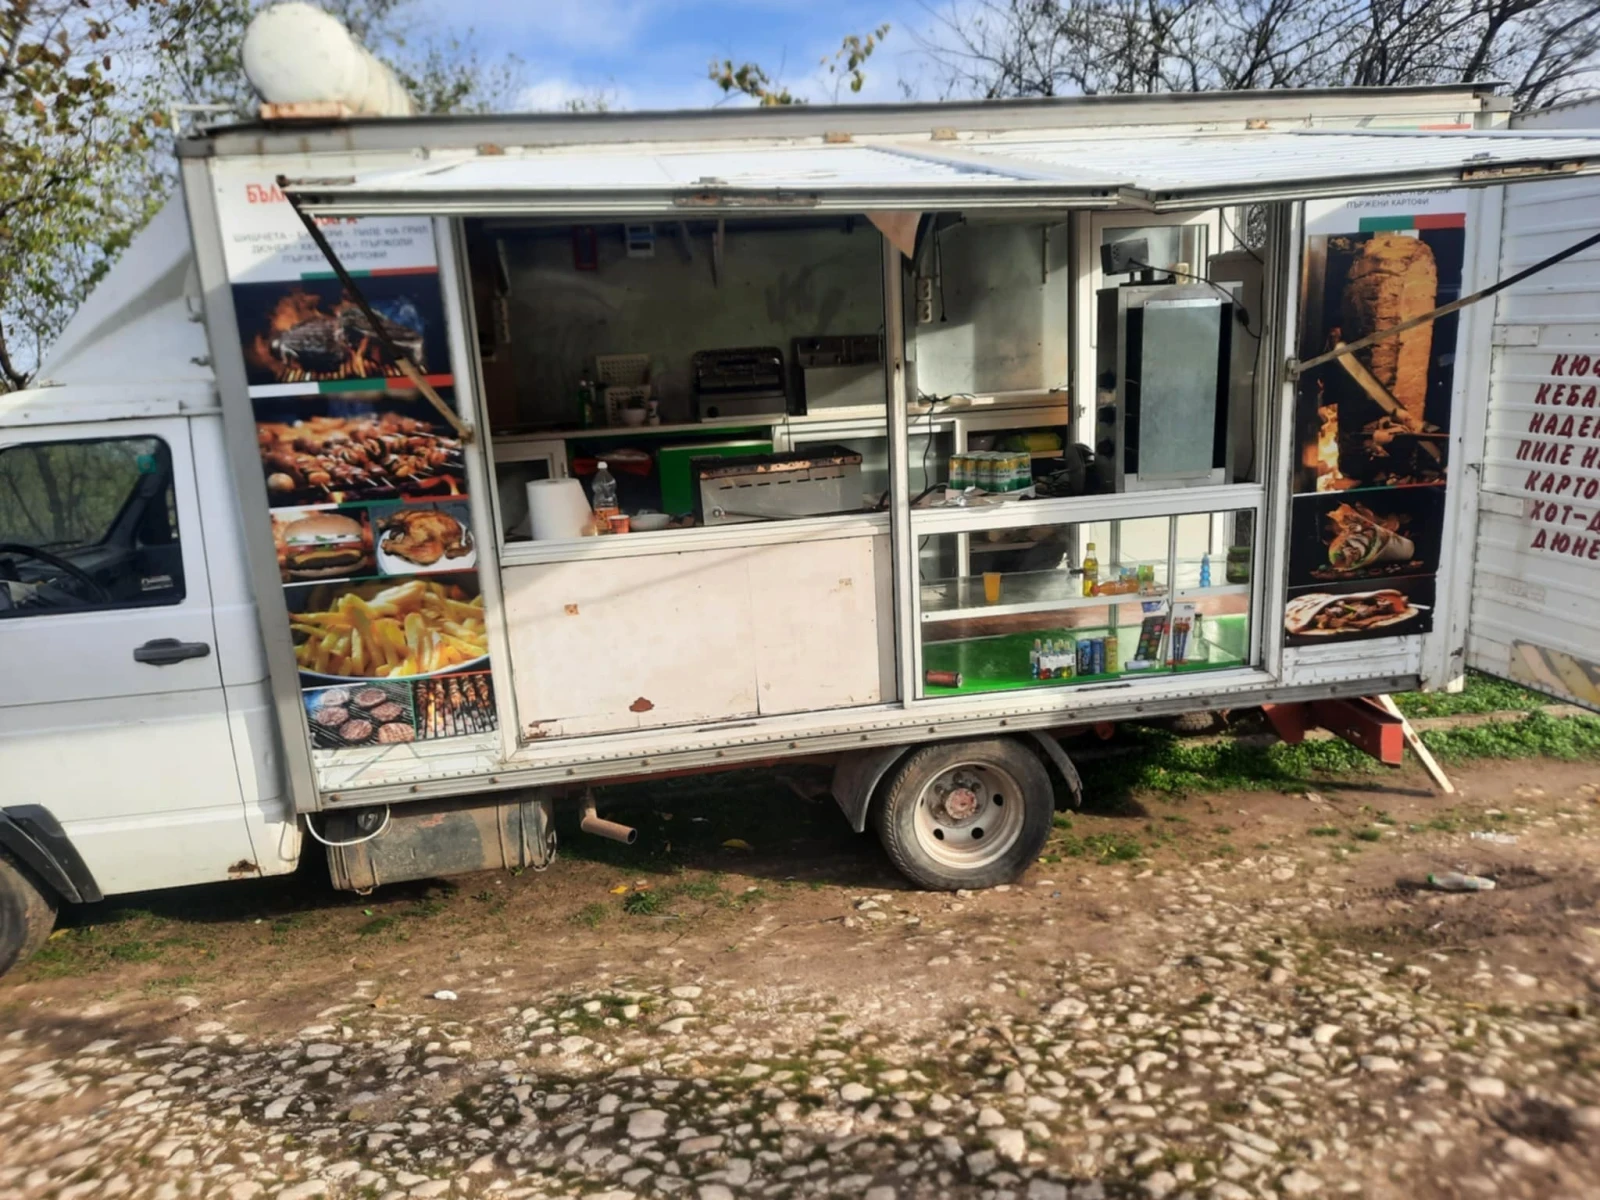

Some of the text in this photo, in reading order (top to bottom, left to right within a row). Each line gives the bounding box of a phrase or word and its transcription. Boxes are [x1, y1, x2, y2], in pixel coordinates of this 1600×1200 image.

[1347, 197, 1430, 209] ПЪРЖЕНИ КАРТОФИ
[1534, 383, 1600, 408] КЕБА
[1516, 440, 1575, 465] ПИЛЕ
[1524, 470, 1599, 499] КАРТО
[1530, 528, 1600, 560] ДЮНЕ
